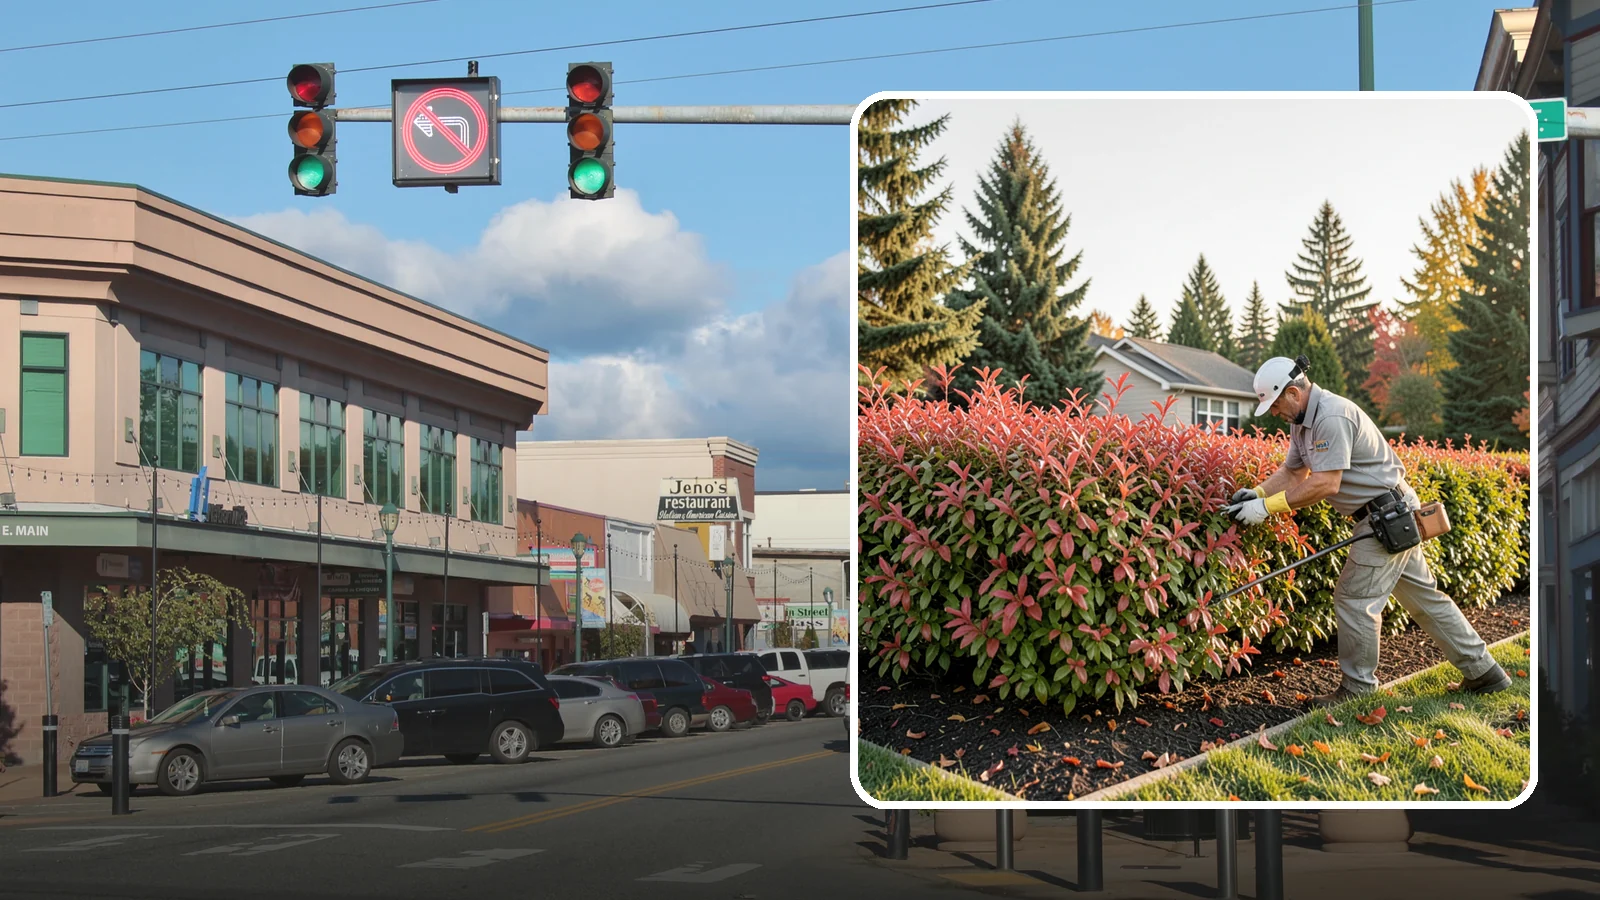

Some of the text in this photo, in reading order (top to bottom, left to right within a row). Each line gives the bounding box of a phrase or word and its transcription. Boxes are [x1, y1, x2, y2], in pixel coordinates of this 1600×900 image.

[670, 480, 727, 494] Jeno's
[665, 496, 731, 509] restaurant
[658, 510, 681, 519] Italian
[686, 510, 714, 519] American
[715, 509, 737, 519] Cuisine
[2, 525, 49, 536] E. MAIN
[797, 607, 828, 616] Street
